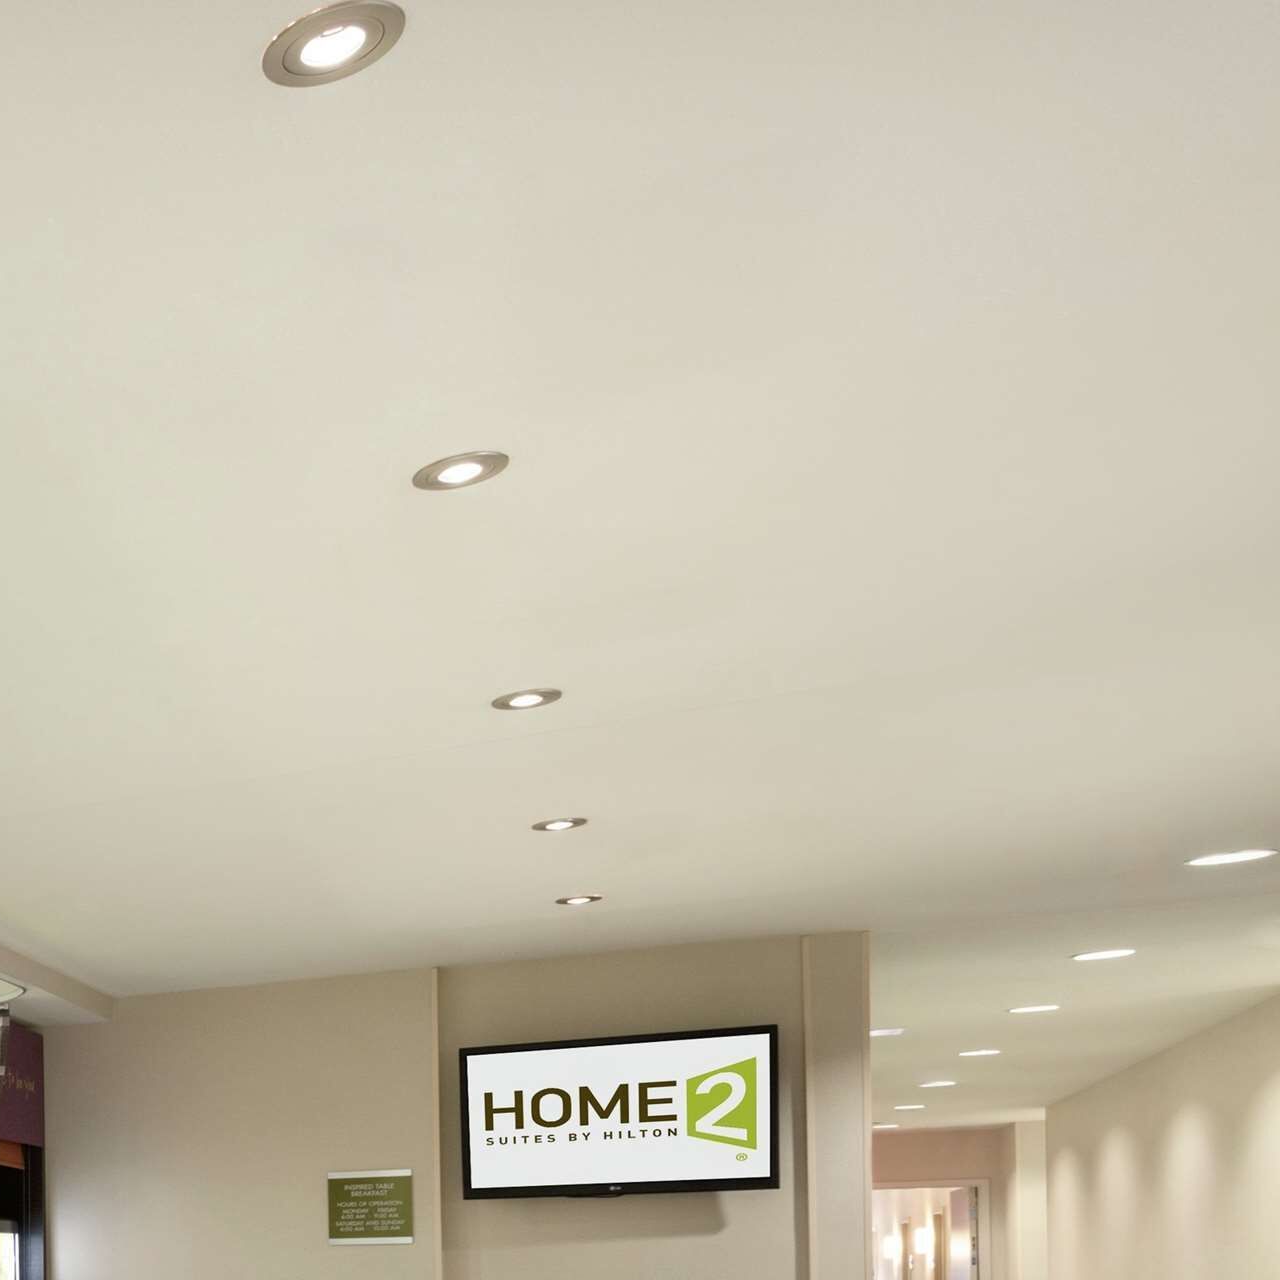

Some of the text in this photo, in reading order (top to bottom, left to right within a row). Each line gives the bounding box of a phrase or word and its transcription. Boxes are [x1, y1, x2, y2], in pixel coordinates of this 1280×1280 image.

[483, 1069, 750, 1143] HOME 2
[486, 1127, 678, 1146] SUITES BY HILTON
